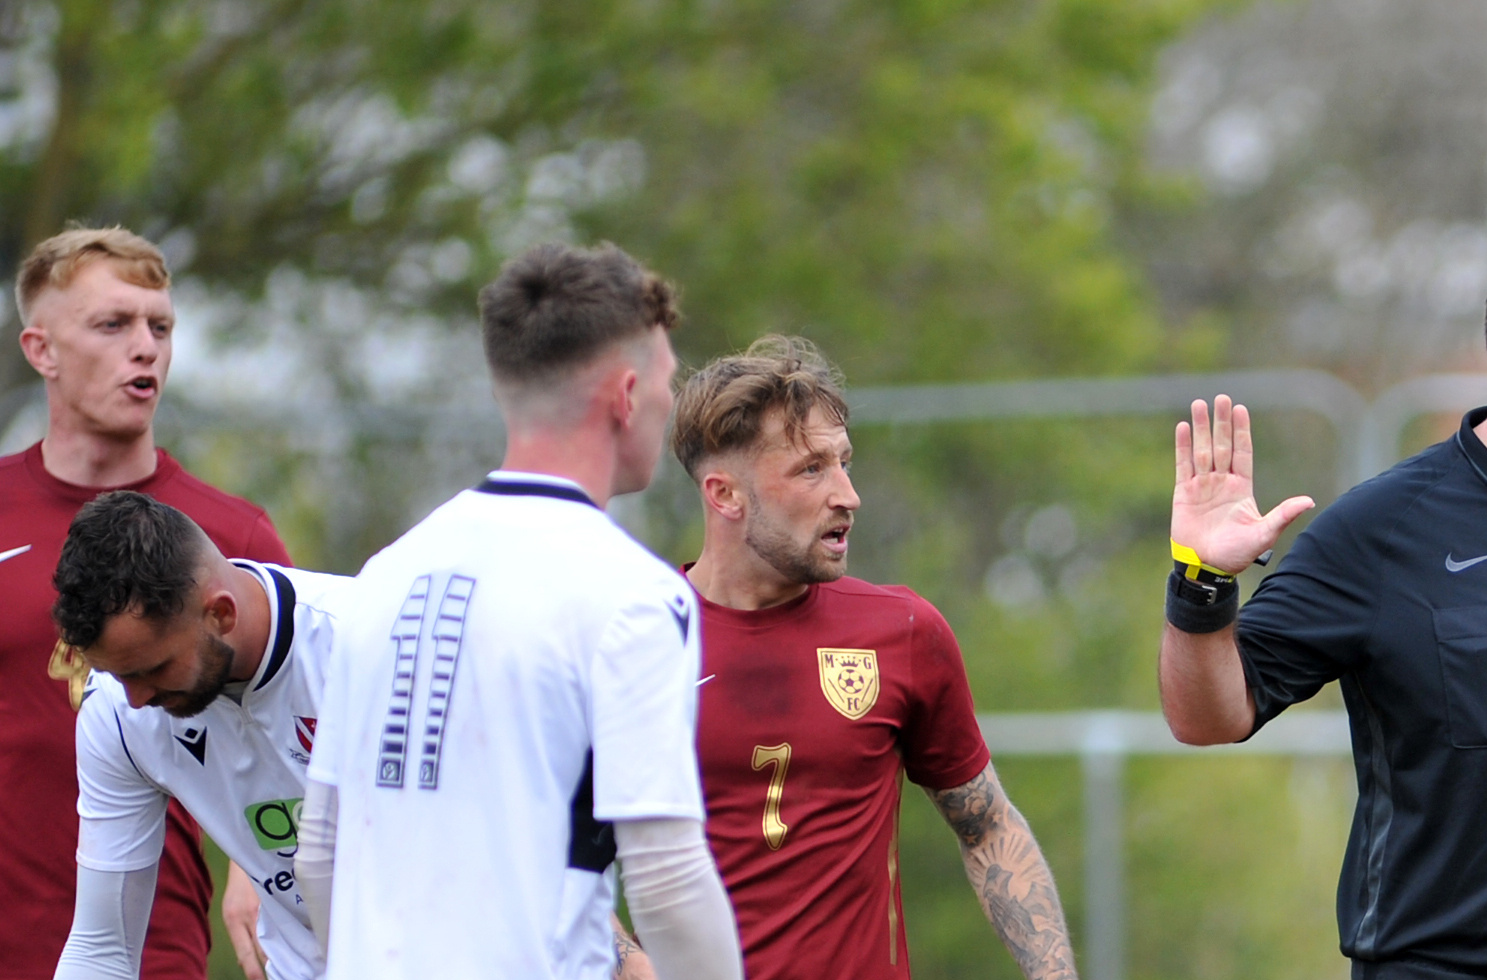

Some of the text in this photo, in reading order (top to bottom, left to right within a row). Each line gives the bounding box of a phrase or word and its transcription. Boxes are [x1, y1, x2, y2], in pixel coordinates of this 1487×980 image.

[375, 573, 477, 790] 11
[824, 653, 872, 670] M G
[847, 697, 860, 711] FC
[751, 742, 792, 850] 7
